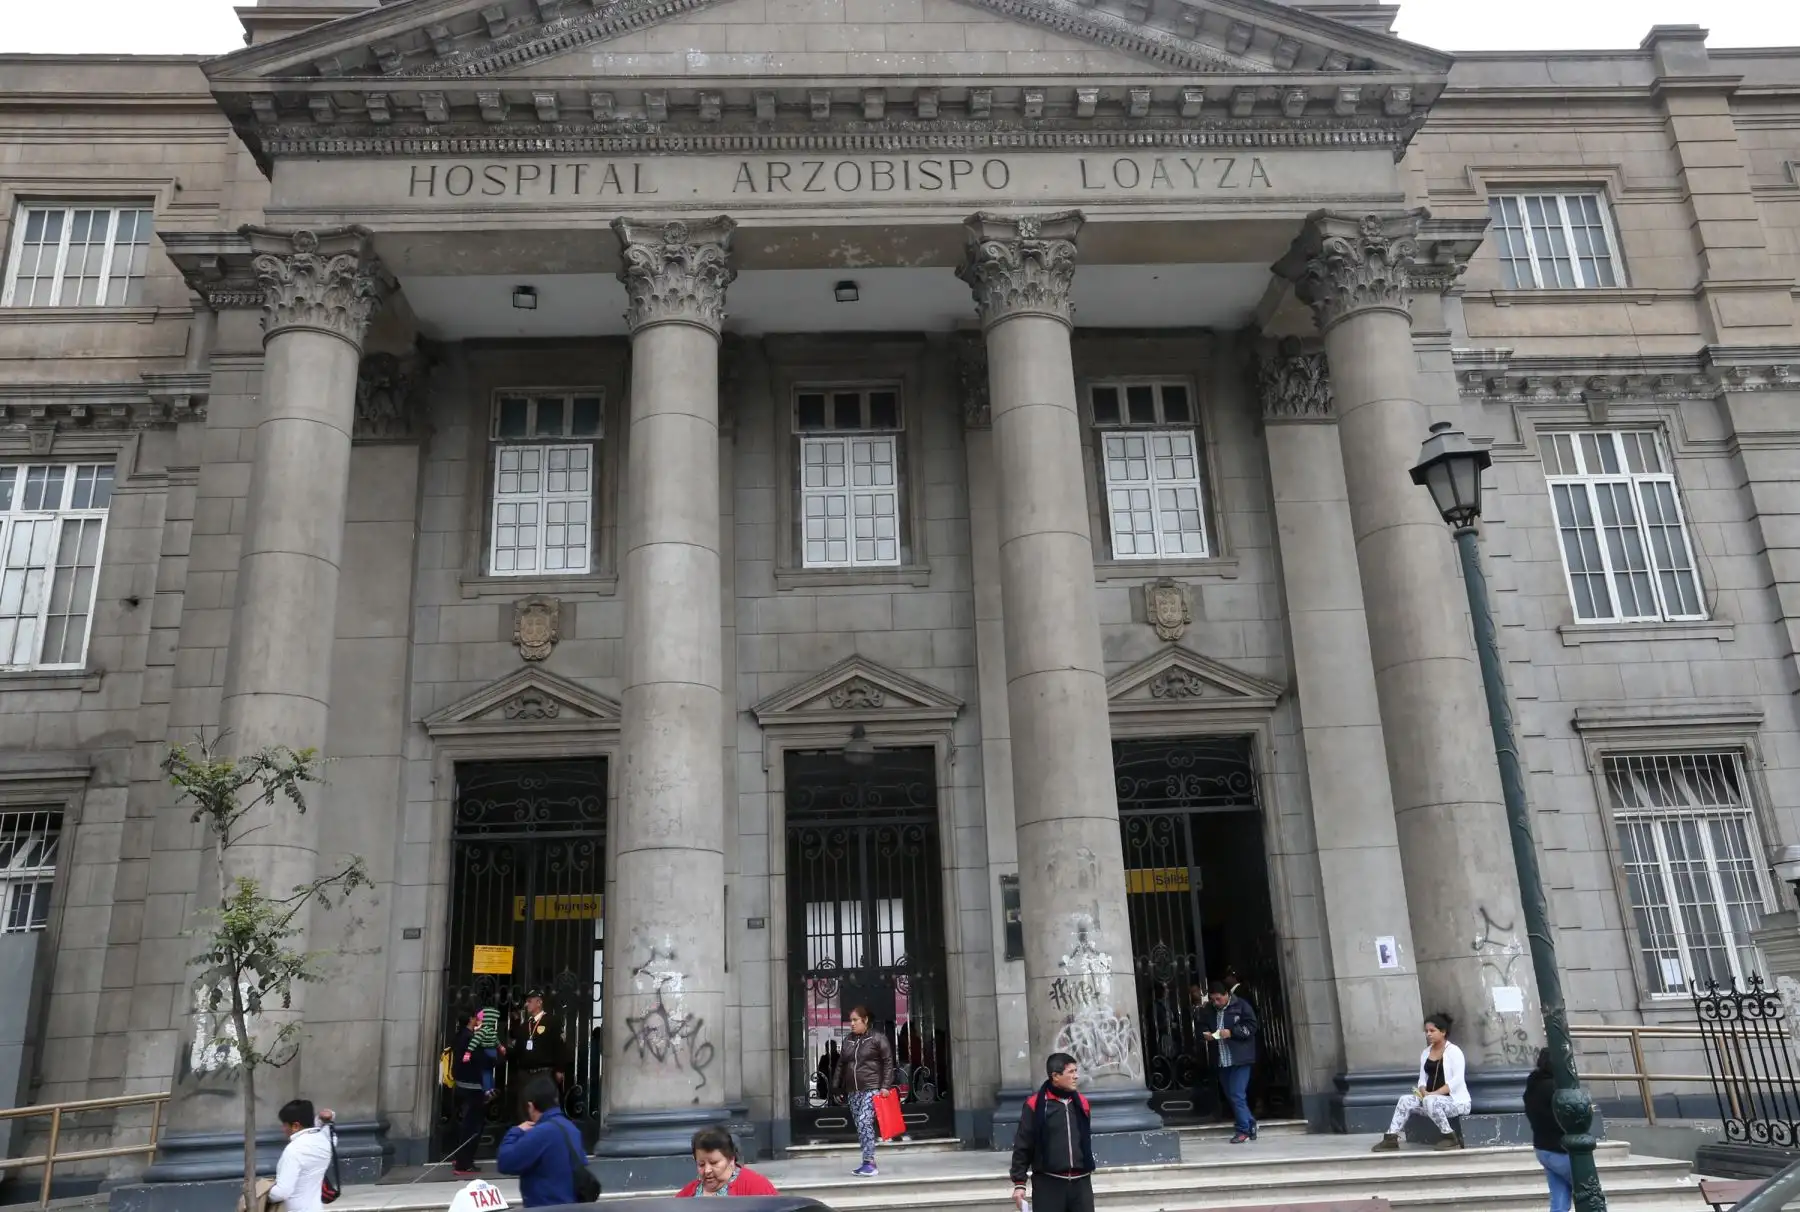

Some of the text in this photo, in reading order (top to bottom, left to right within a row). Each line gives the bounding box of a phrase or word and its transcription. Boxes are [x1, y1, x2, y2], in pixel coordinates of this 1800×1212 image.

[408, 156, 1273, 197] HOSPITAL ARZOBISPO LOAYZA
[469, 1188, 502, 1208] TAXI
